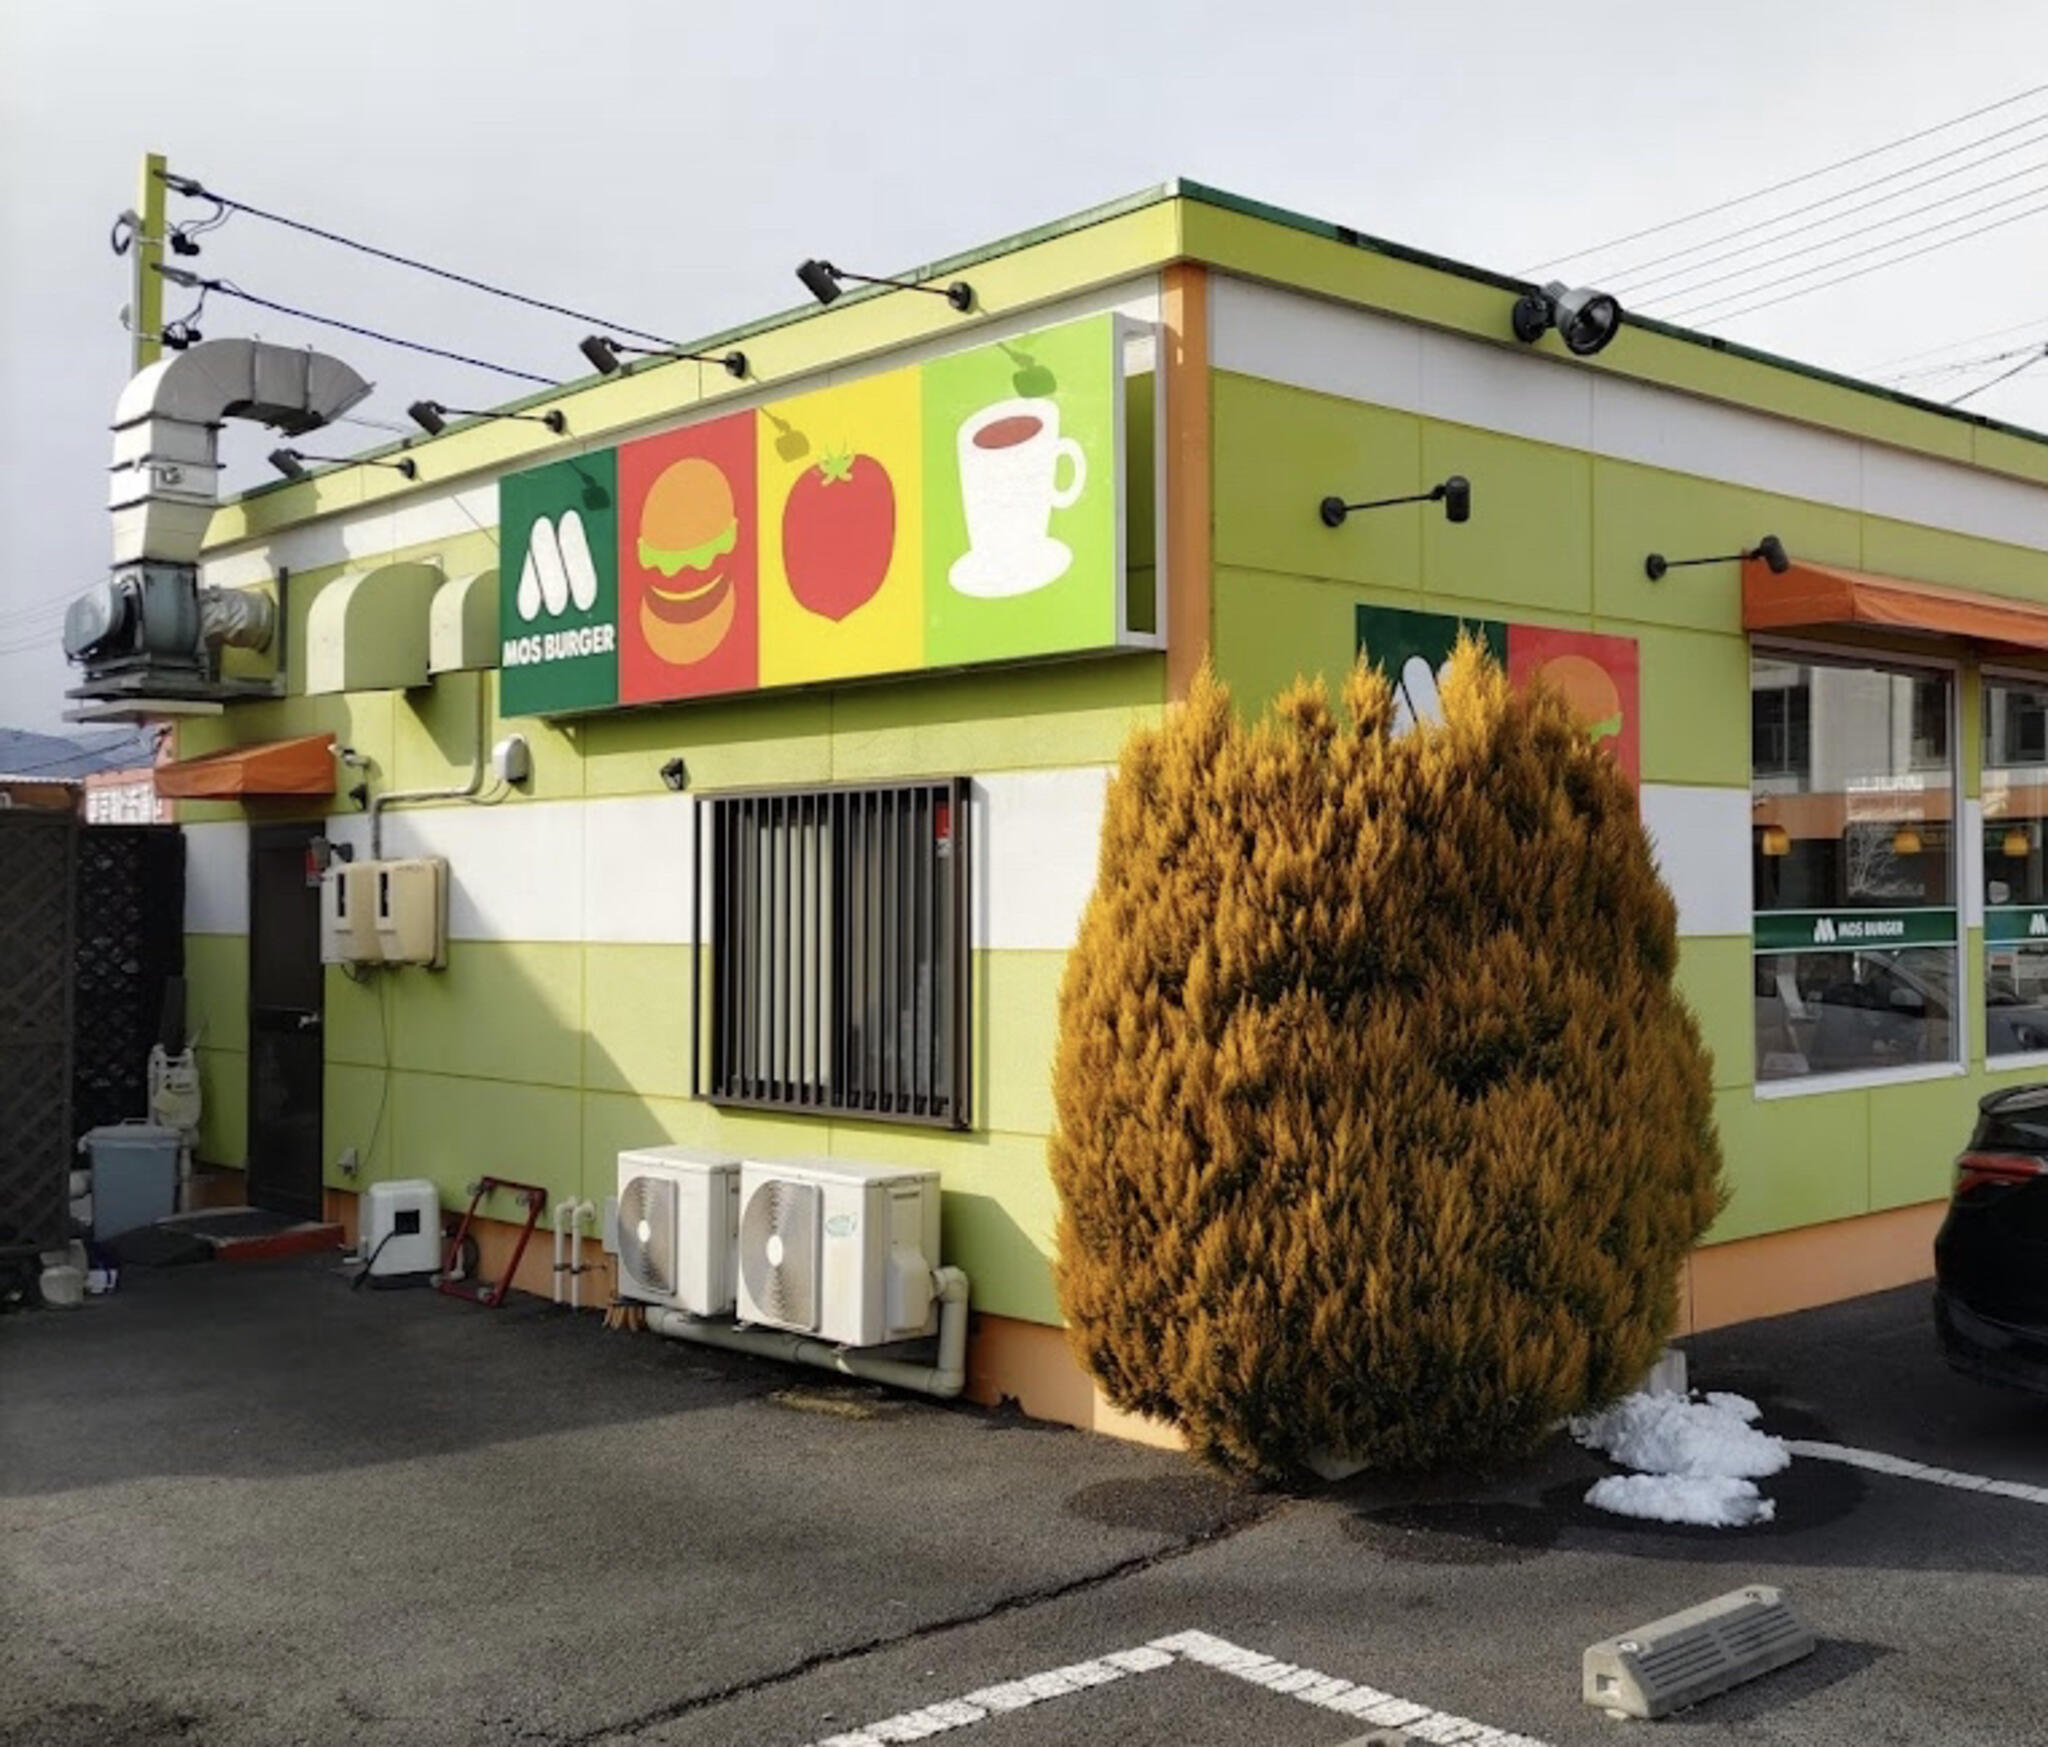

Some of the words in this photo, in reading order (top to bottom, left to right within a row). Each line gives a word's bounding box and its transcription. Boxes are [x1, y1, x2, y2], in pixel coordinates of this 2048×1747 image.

[502, 634, 542, 667] MOS
[544, 624, 614, 661] BURGER
[1838, 921, 1863, 938] MOS
[1865, 920, 1904, 936] BURGER
